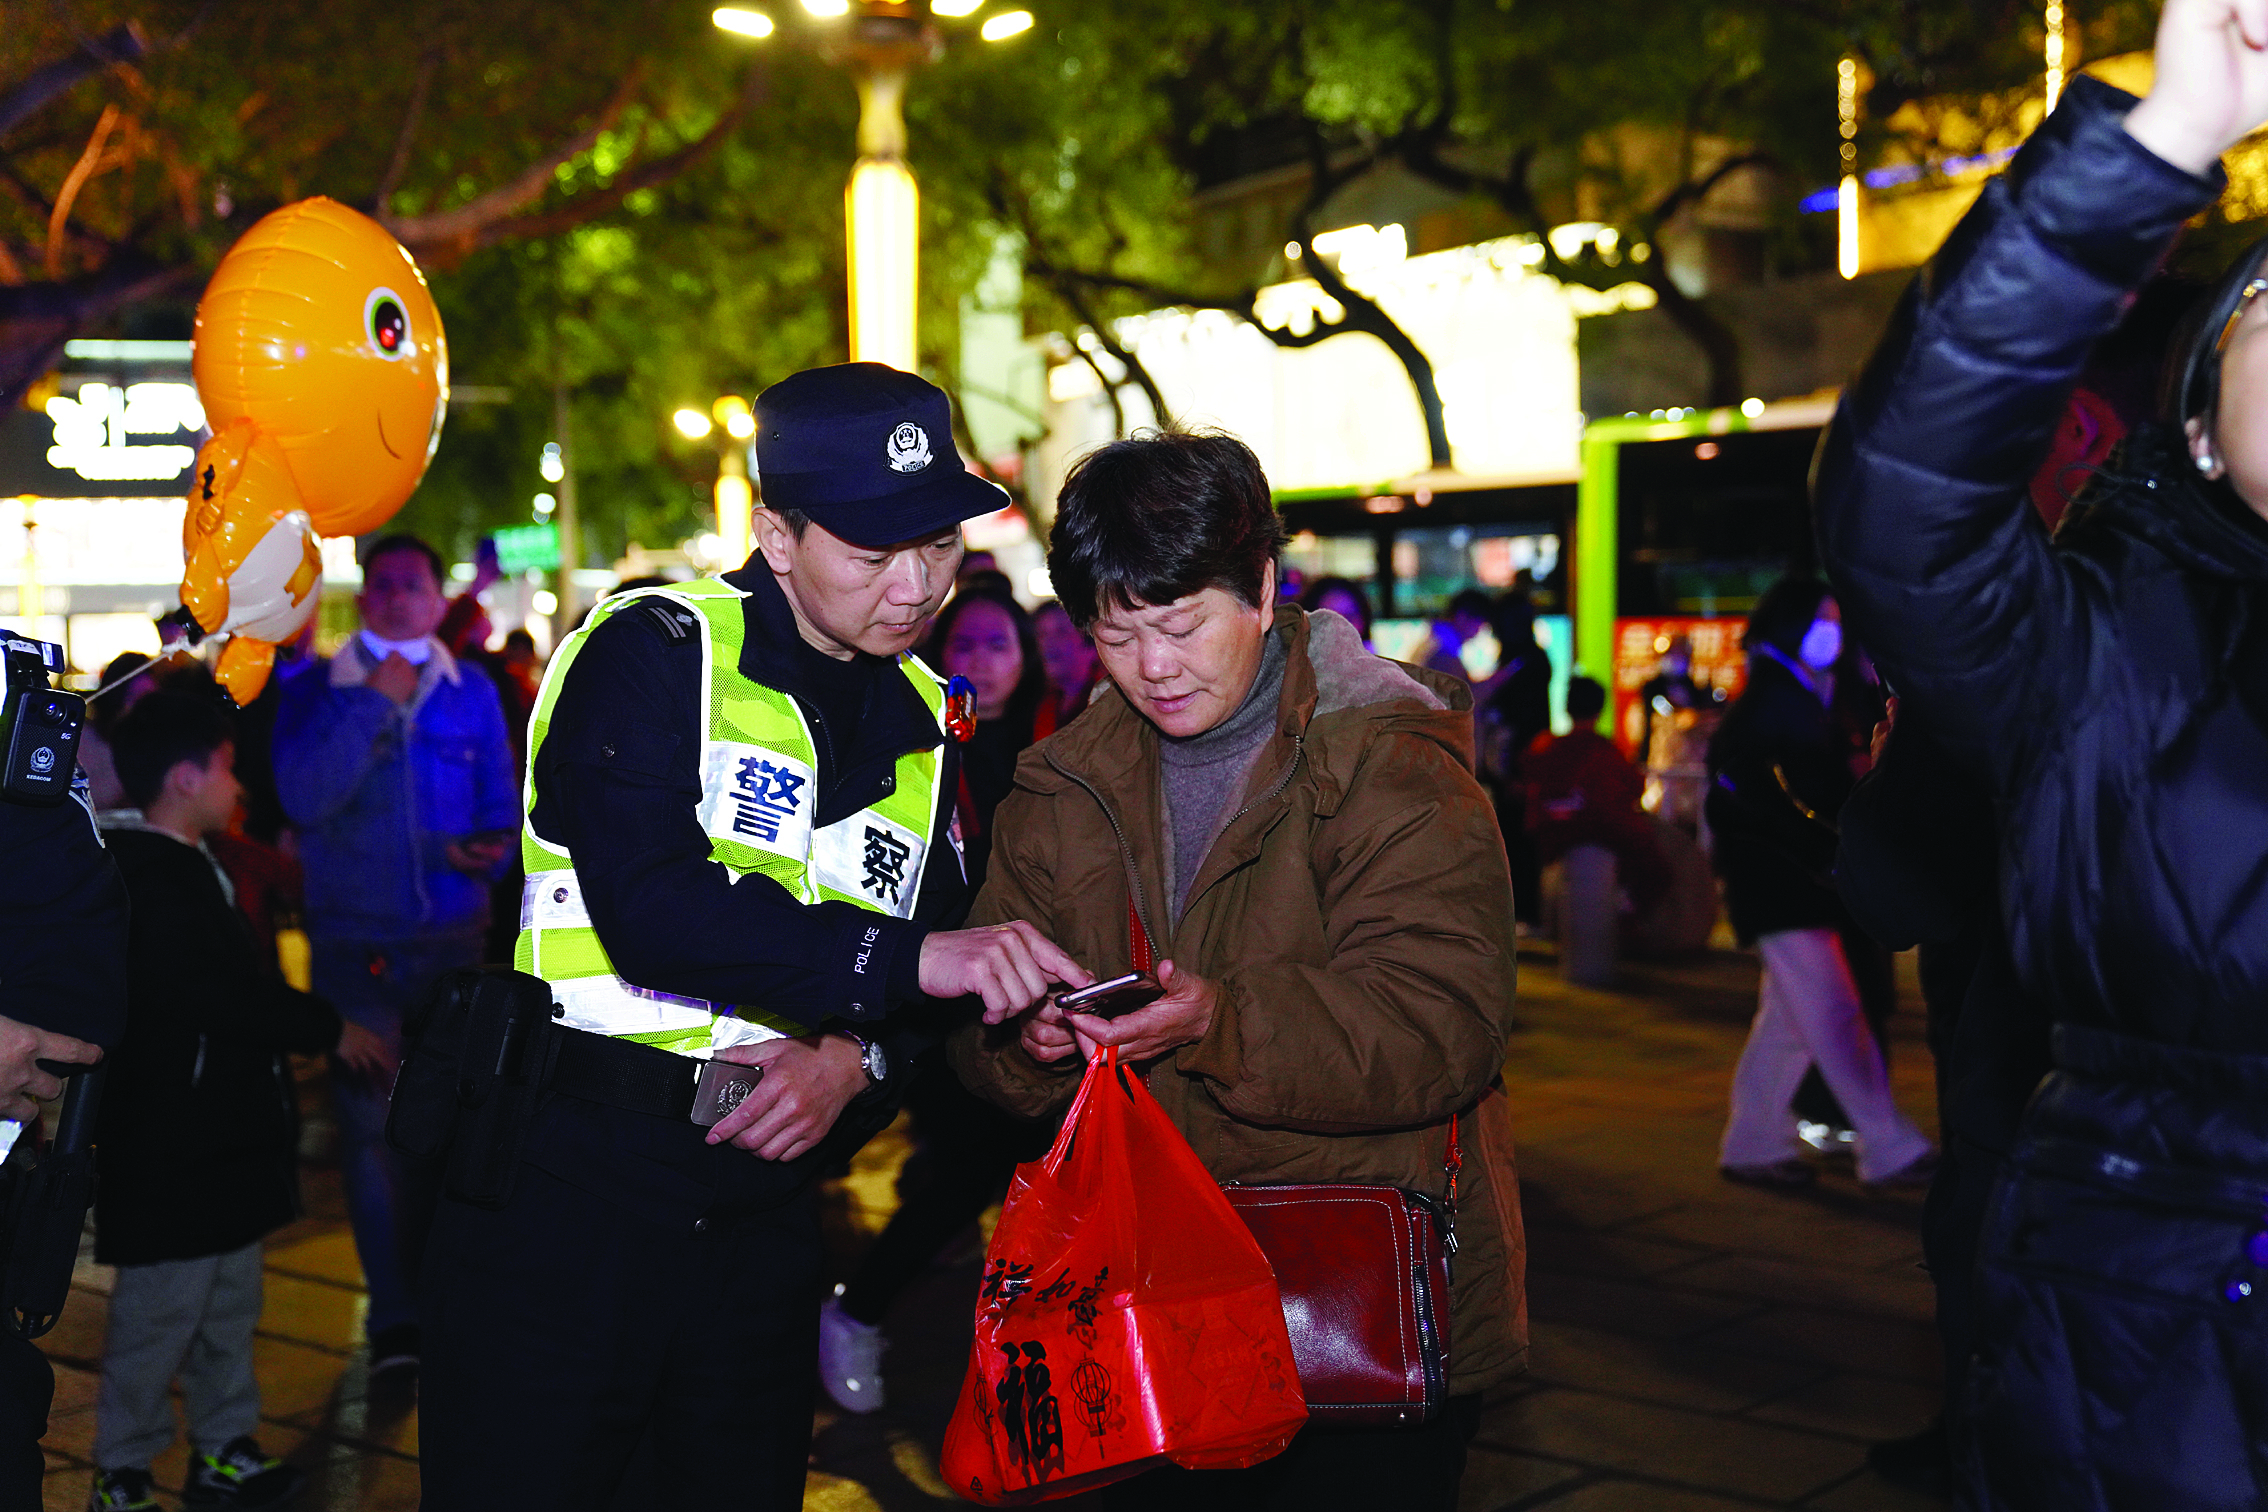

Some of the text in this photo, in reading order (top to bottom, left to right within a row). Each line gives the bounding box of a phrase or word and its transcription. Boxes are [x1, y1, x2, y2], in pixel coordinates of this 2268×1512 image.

[61, 732, 72, 740] 5G
[729, 756, 911, 906] 警 察
[854, 926, 880, 974] POLICE
[996, 1340, 1064, 1466] 福
